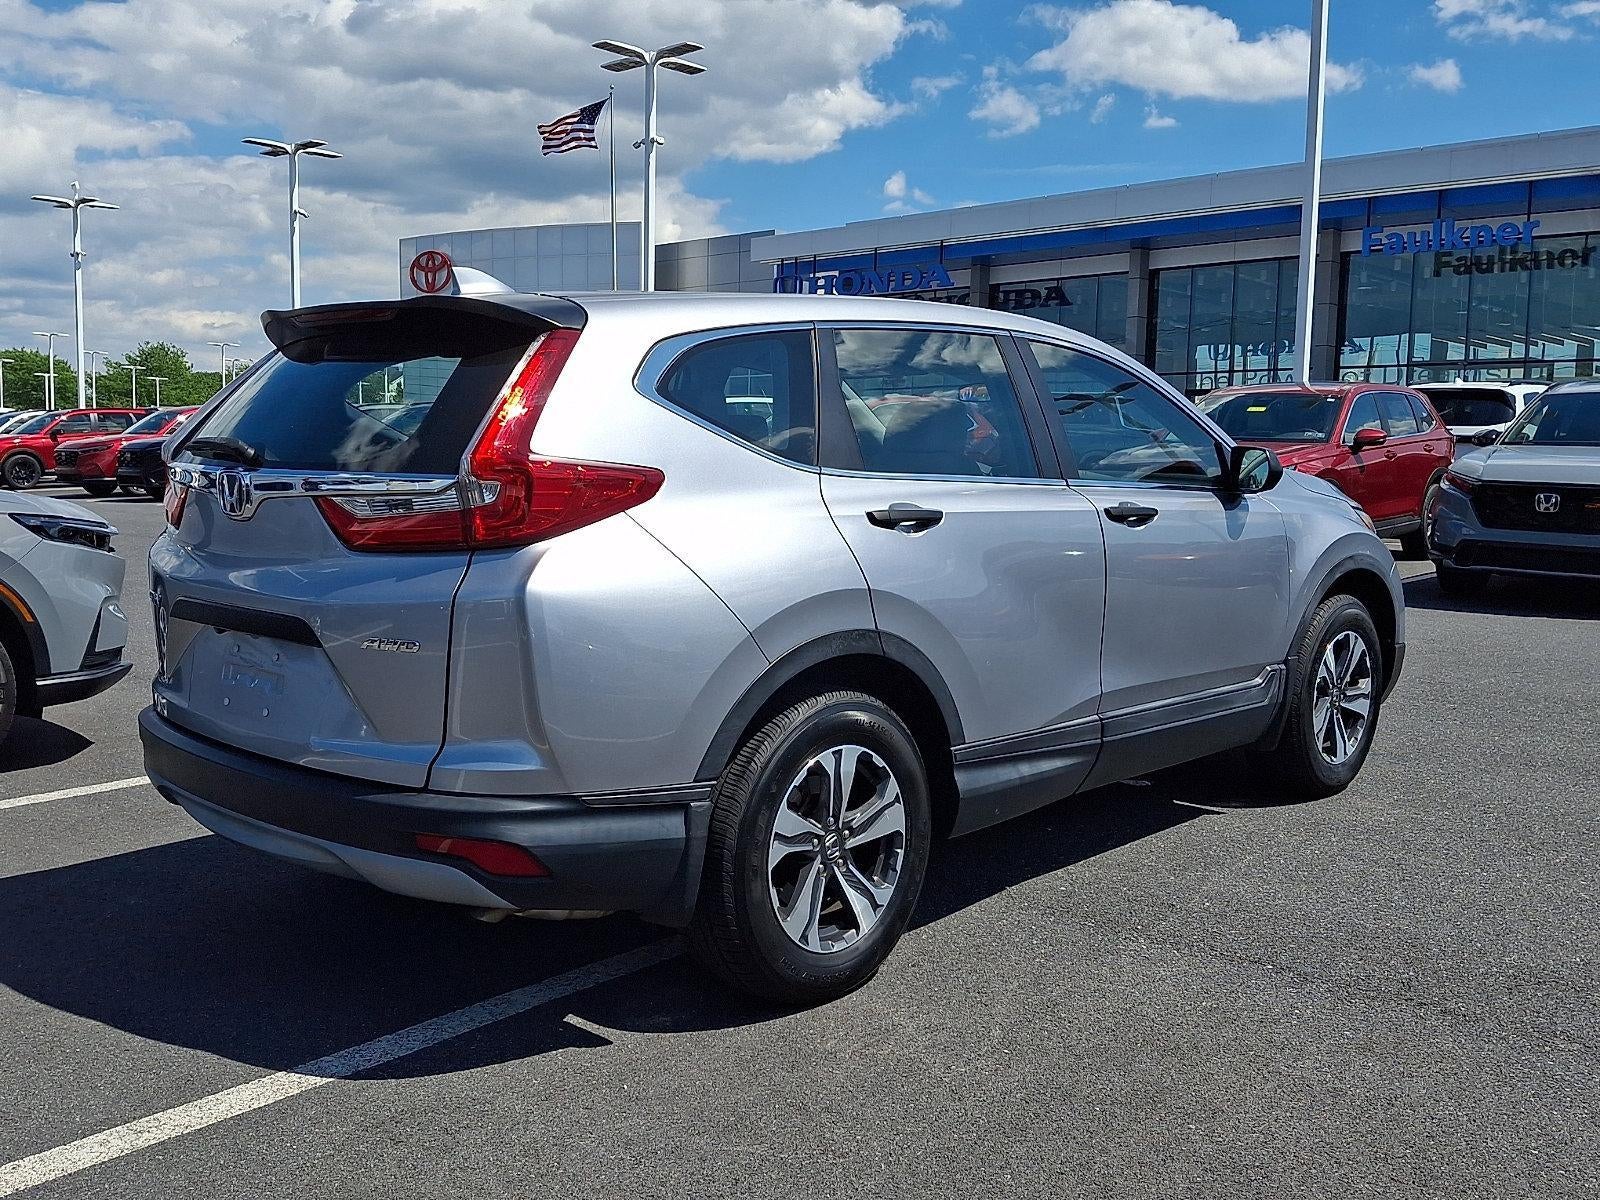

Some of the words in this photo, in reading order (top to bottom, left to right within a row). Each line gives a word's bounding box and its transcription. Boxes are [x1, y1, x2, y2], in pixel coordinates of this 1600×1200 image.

[1362, 218, 1541, 257] Faulkner
[809, 263, 955, 295] HONDA
[360, 637, 421, 653] AWD
